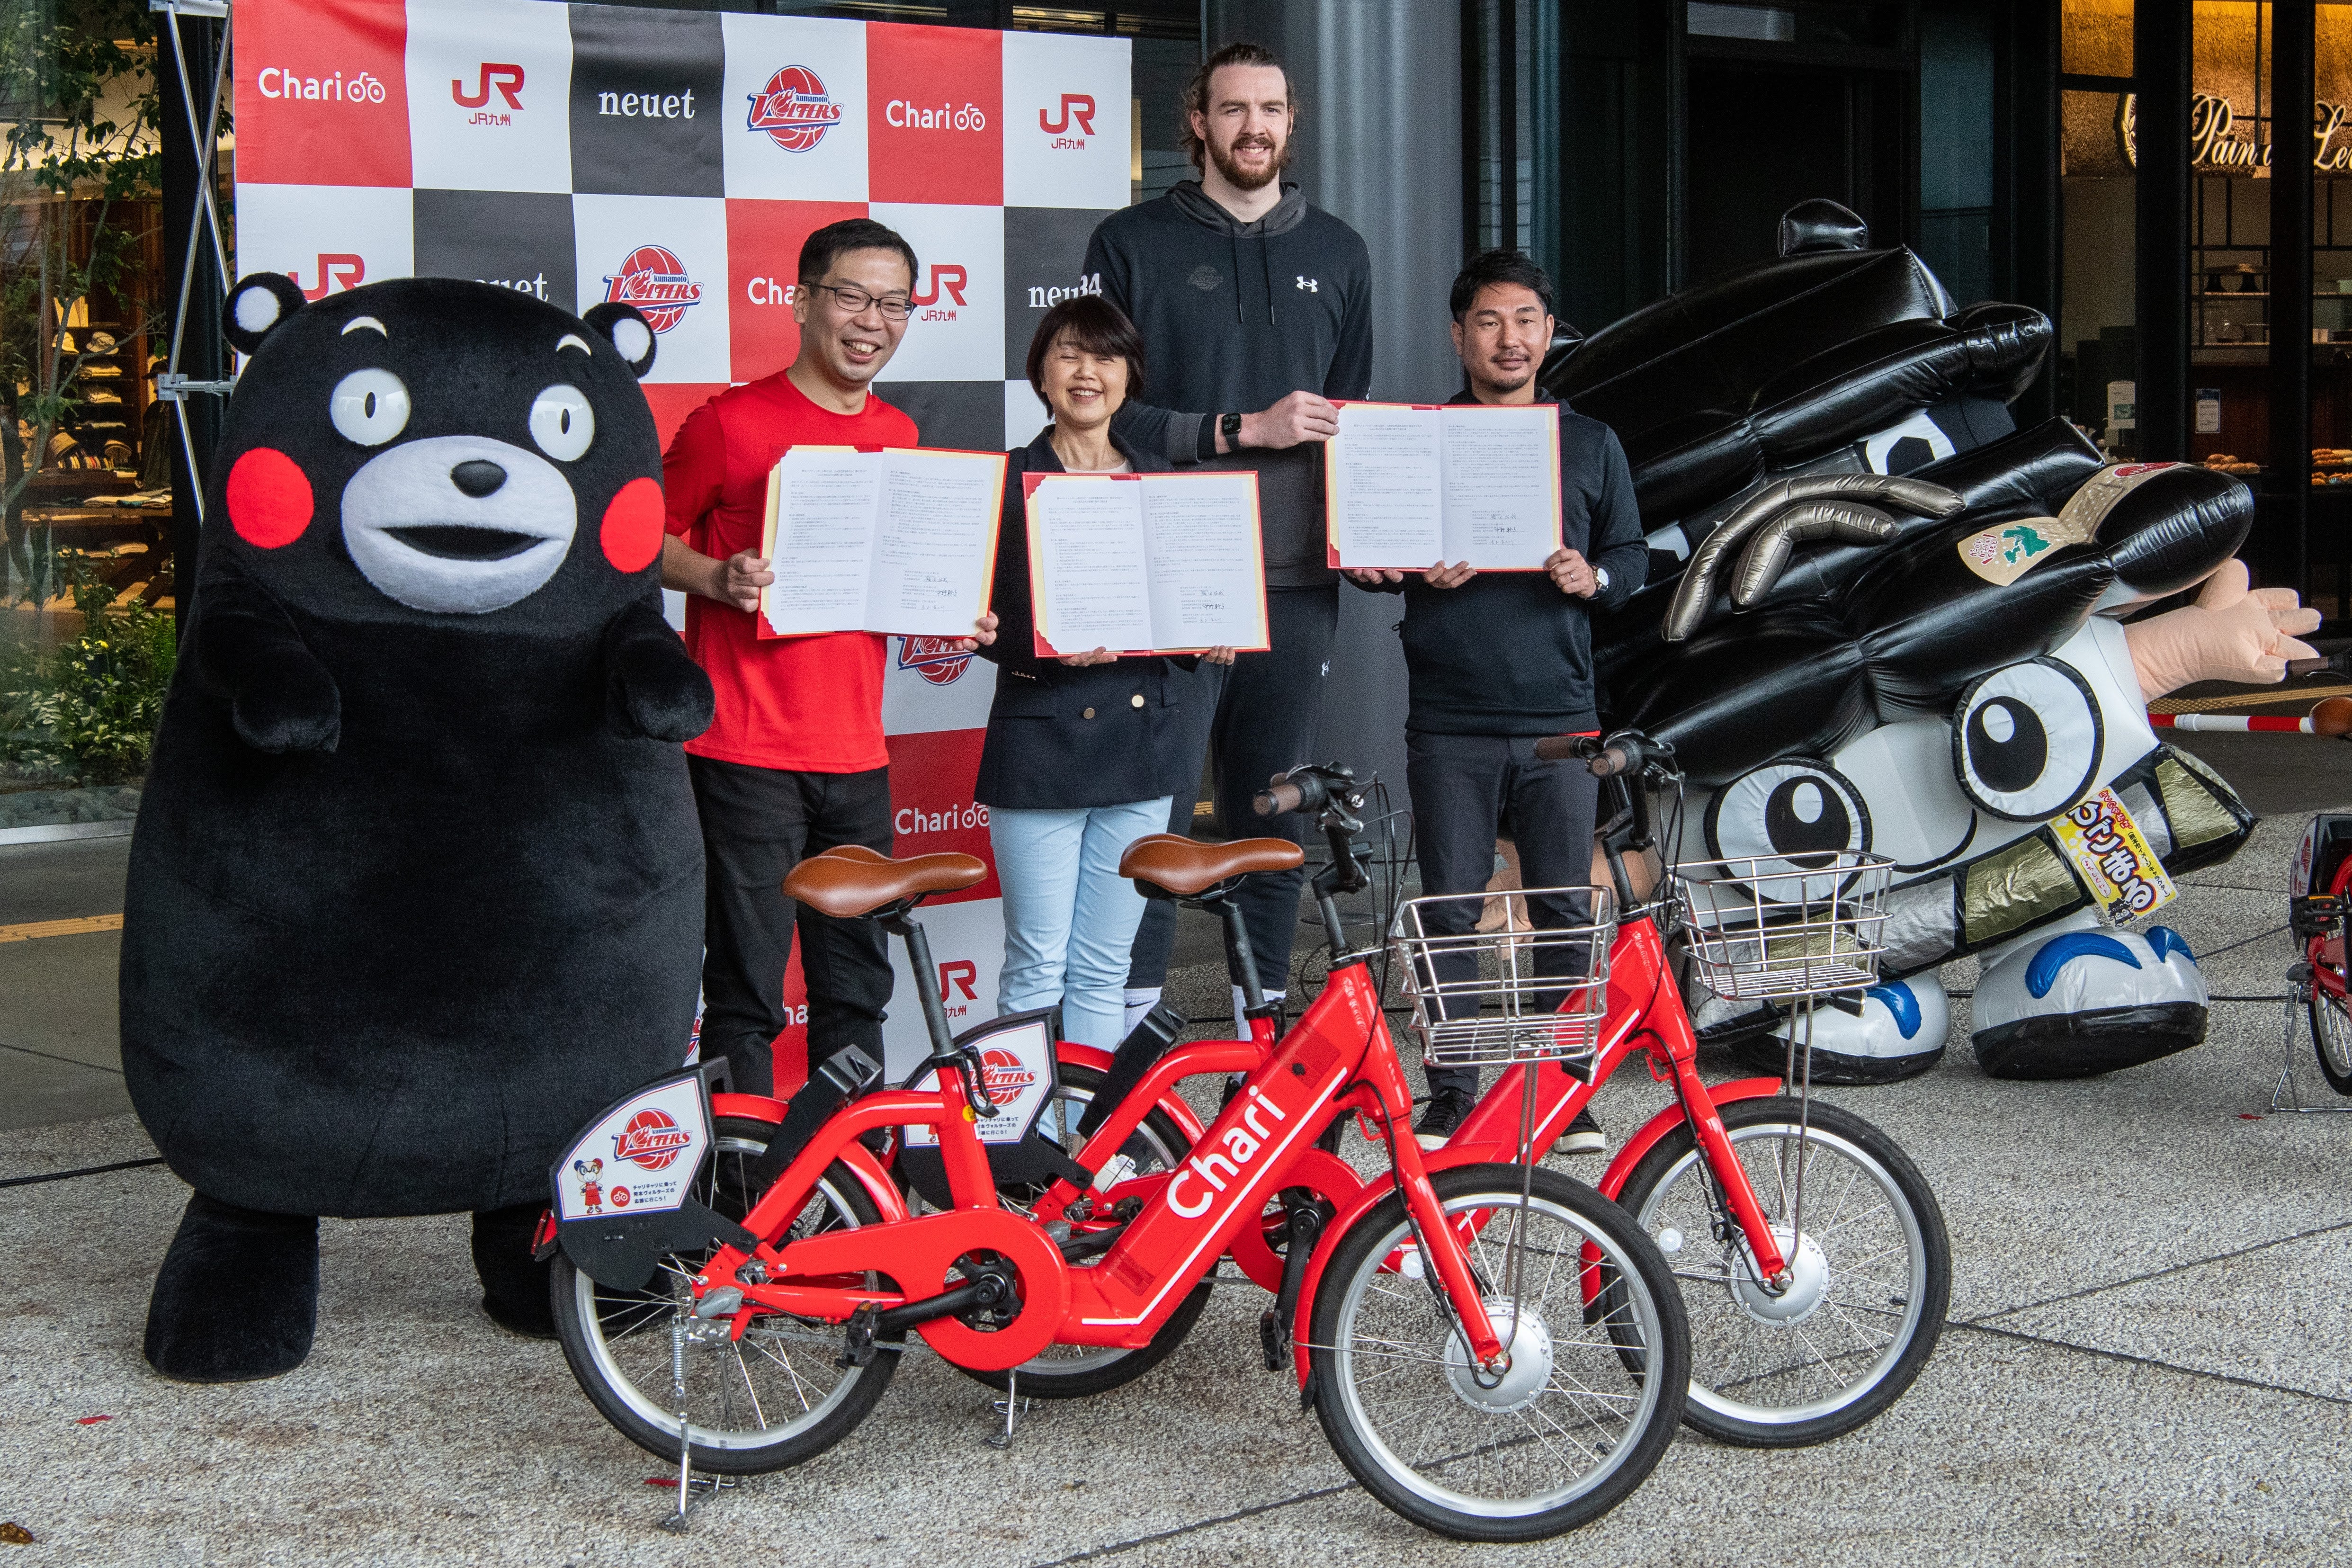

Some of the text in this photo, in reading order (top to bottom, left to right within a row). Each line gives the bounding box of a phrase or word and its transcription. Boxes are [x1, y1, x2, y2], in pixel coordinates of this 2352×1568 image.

[259, 67, 342, 101] Chari
[452, 63, 525, 110] JR
[796, 94, 827, 103] kumamoto
[598, 89, 695, 119] neuet
[886, 100, 950, 129] Chari
[1040, 94, 1095, 135] JR
[468, 113, 510, 126] JR九州
[2192, 92, 2258, 166] Pain
[1052, 138, 1085, 150] JR九州
[288, 254, 365, 301] JR
[654, 274, 687, 283] kumamoto
[748, 277, 796, 305] Cha
[1080, 273, 1102, 297] 34
[1028, 287, 1078, 308] neu
[921, 310, 956, 322] JR九州
[895, 804, 958, 835] Chari
[2065, 800, 2157, 912] ひごまる
[1166, 1085, 1285, 1219] Chari
